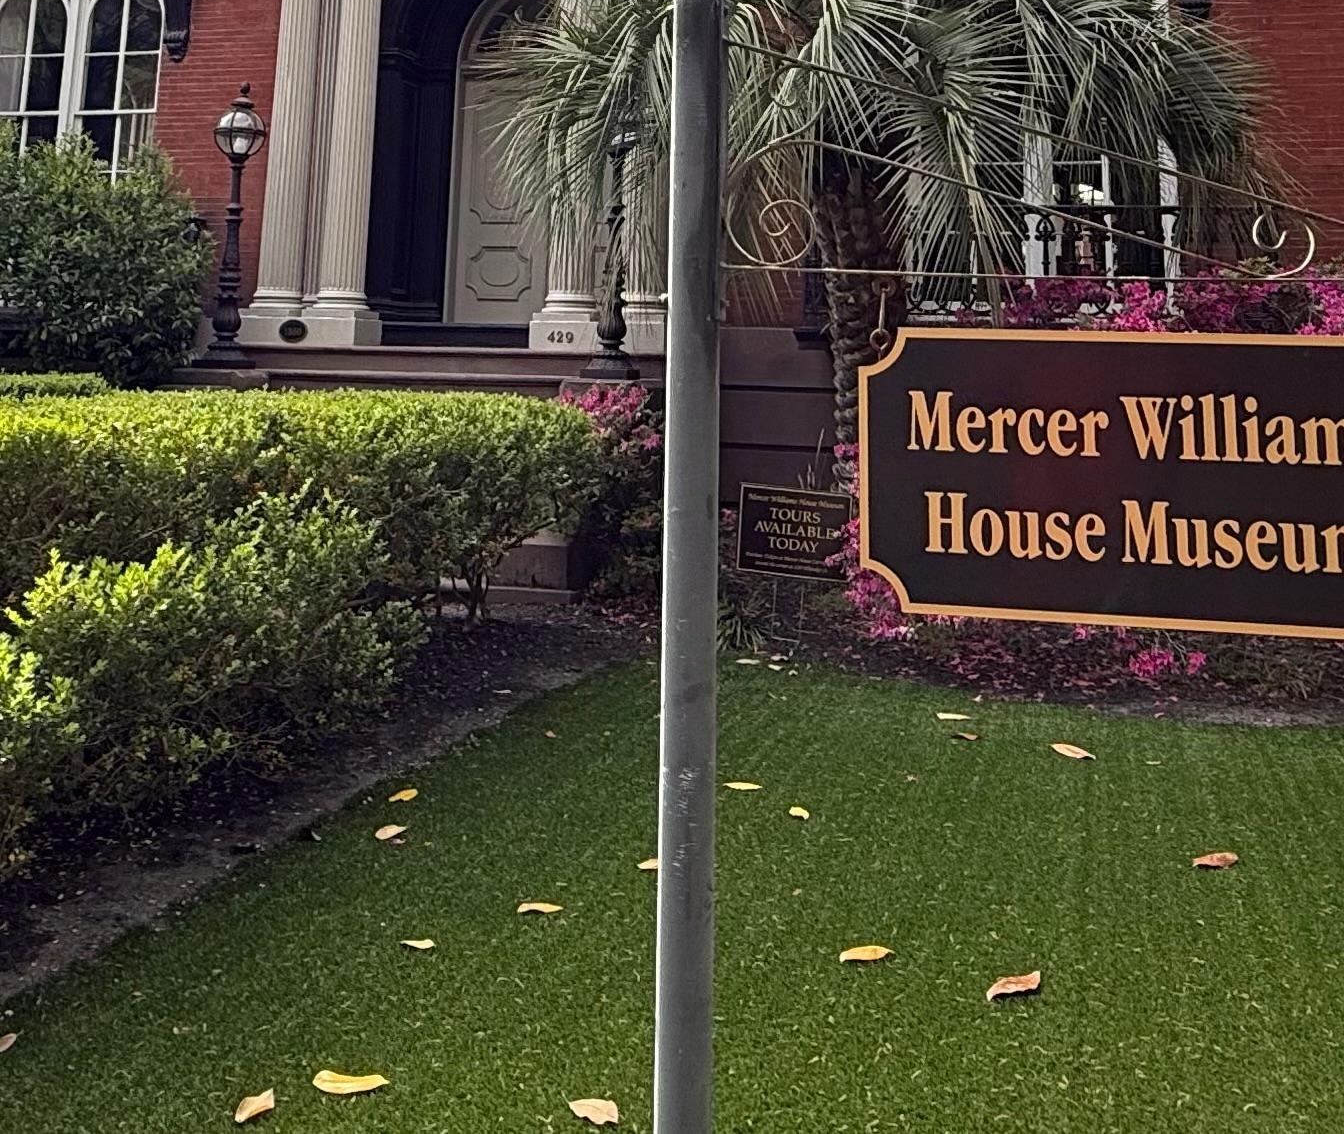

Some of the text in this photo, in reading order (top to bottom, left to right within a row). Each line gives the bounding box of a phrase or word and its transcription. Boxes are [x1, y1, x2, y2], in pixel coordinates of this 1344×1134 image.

[546, 330, 575, 344] 429
[906, 390, 1110, 457] Mercer
[769, 507, 821, 524] TOURS
[754, 520, 835, 540] AVAILABLE
[924, 491, 1107, 562] House
[767, 536, 819, 553] TODAY
